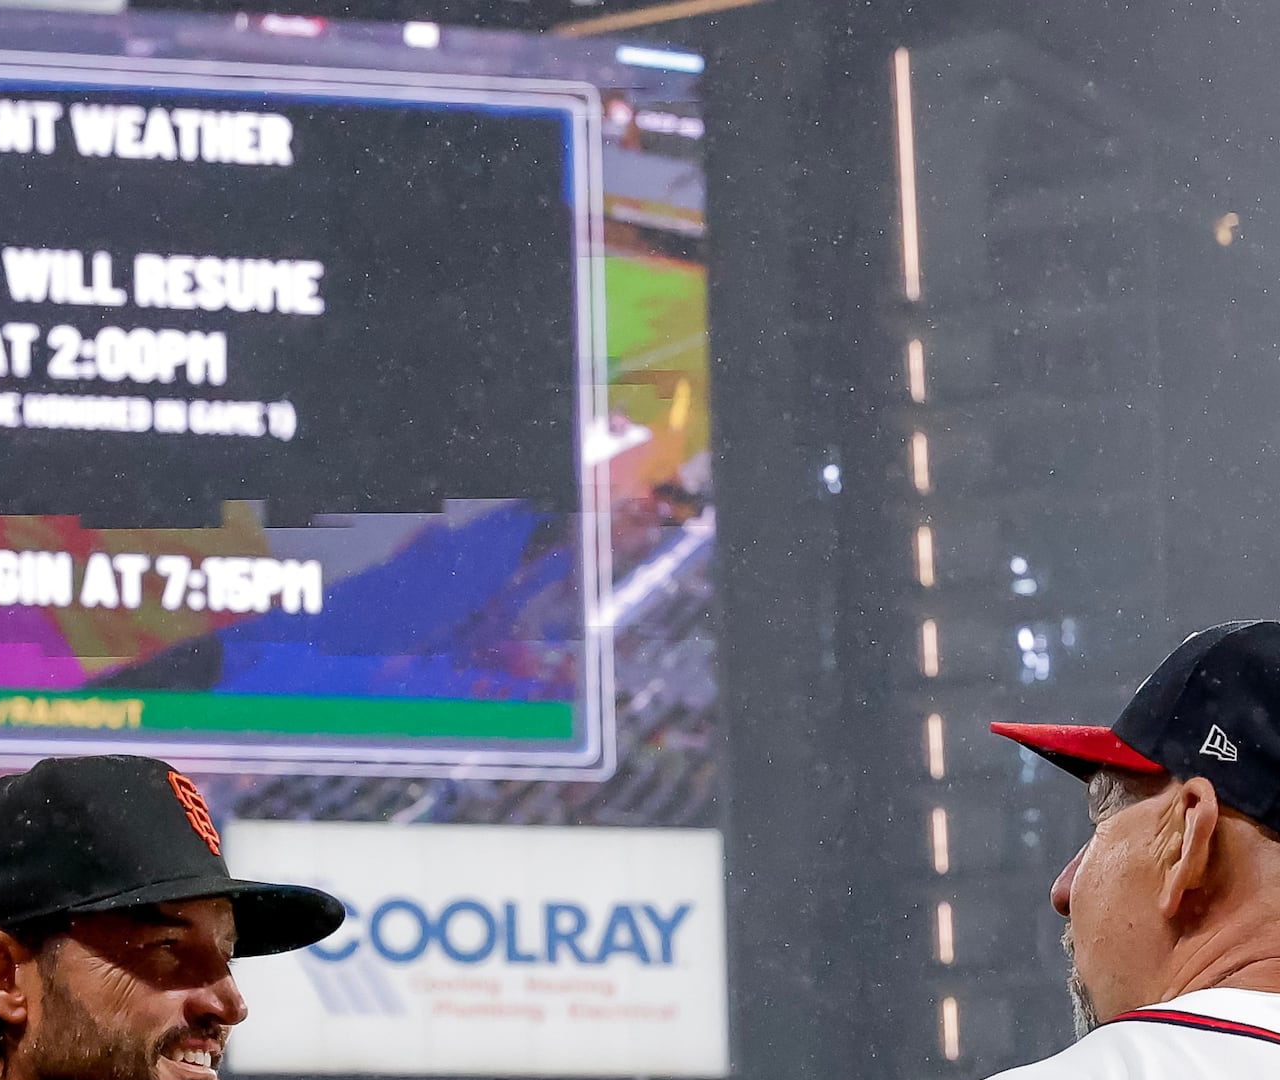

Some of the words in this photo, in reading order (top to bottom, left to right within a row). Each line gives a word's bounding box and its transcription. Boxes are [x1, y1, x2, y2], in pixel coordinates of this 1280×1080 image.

[70, 103, 294, 166] WEATHER
[2, 246, 127, 307] WILL
[134, 253, 325, 315] RESUME
[46, 324, 227, 387] 2:00PM
[80, 552, 150, 609] AT
[155, 554, 322, 615] 7:15PM
[308, 897, 691, 965] COOLRAY
